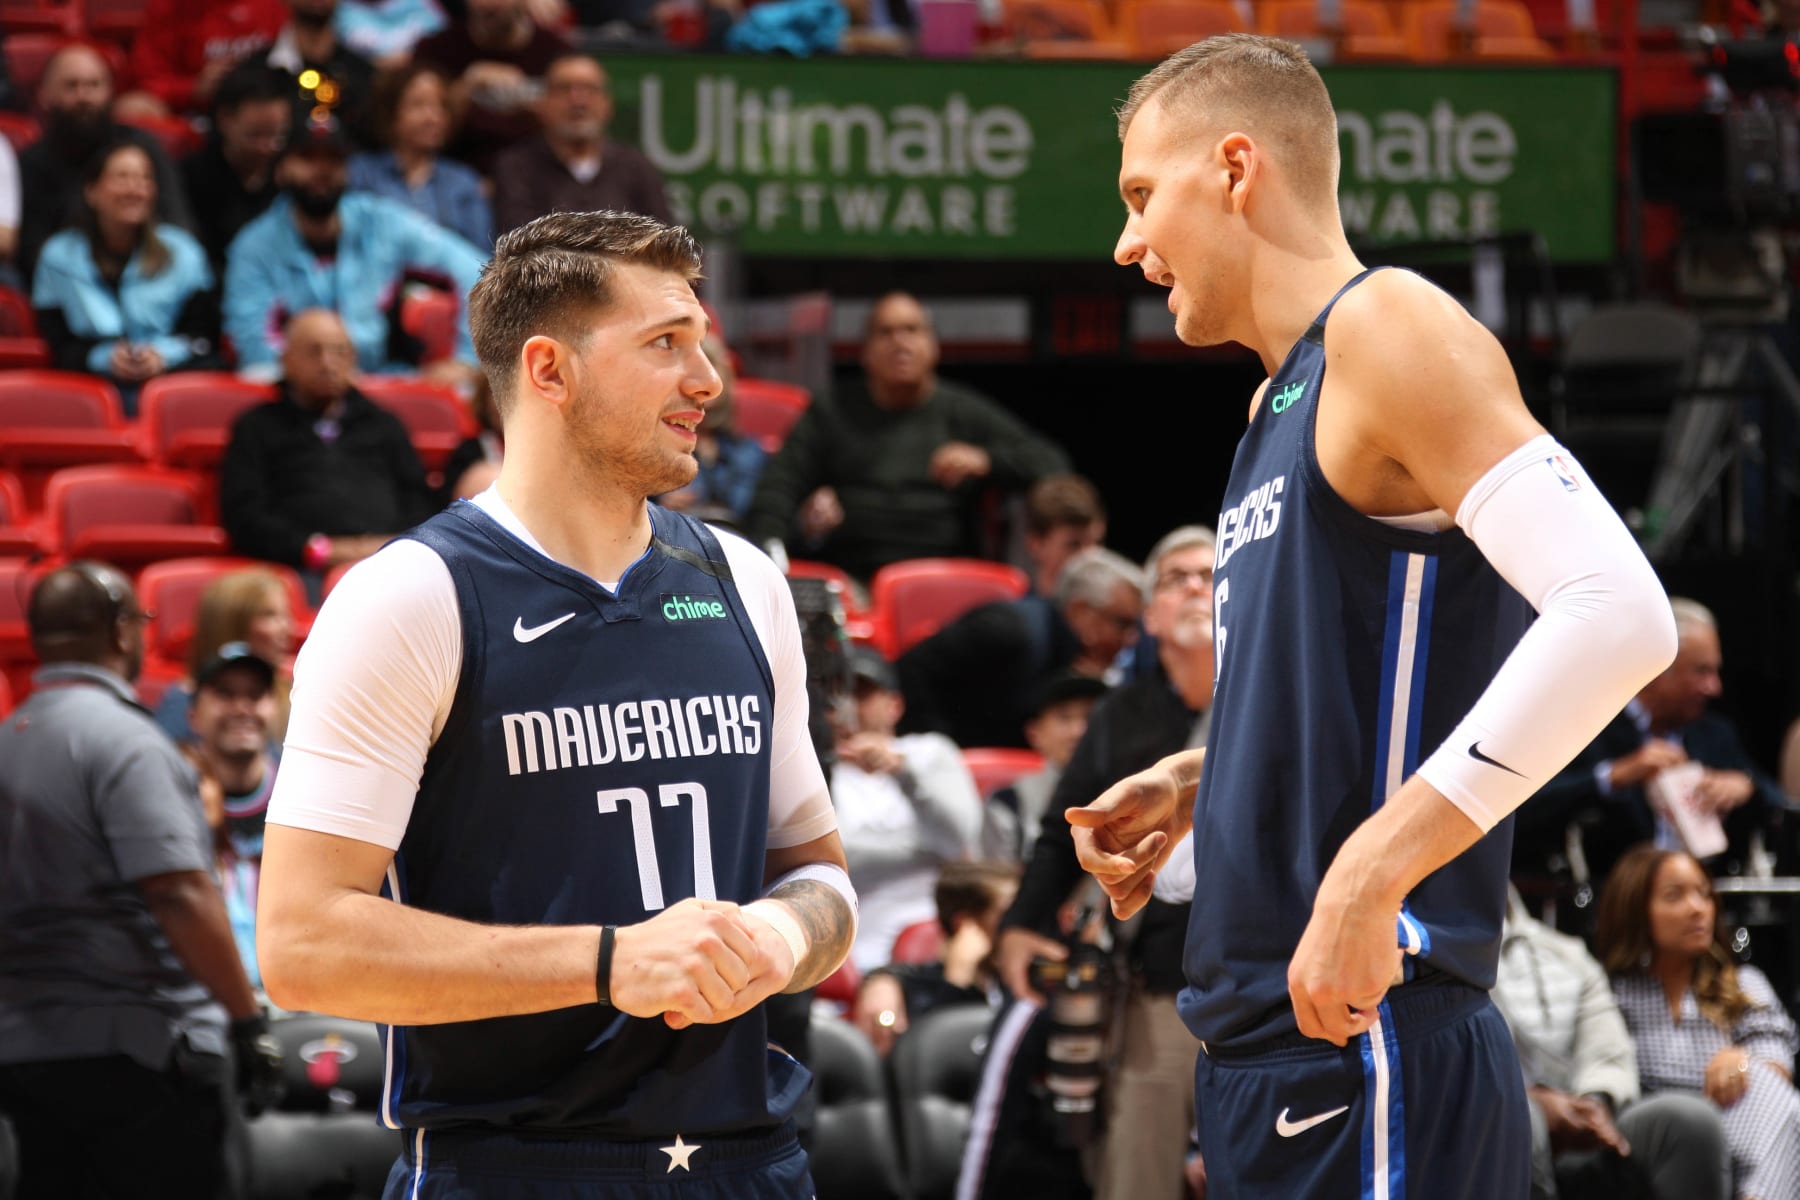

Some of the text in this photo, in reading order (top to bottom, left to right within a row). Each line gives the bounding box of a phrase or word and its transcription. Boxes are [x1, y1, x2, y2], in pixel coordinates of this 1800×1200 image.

[640, 76, 1033, 177] Ultimate
[664, 181, 1017, 236] SOFTWARE
[663, 595, 727, 620] chime
[502, 695, 761, 775] MAVERICKS
[597, 782, 717, 911] 77
